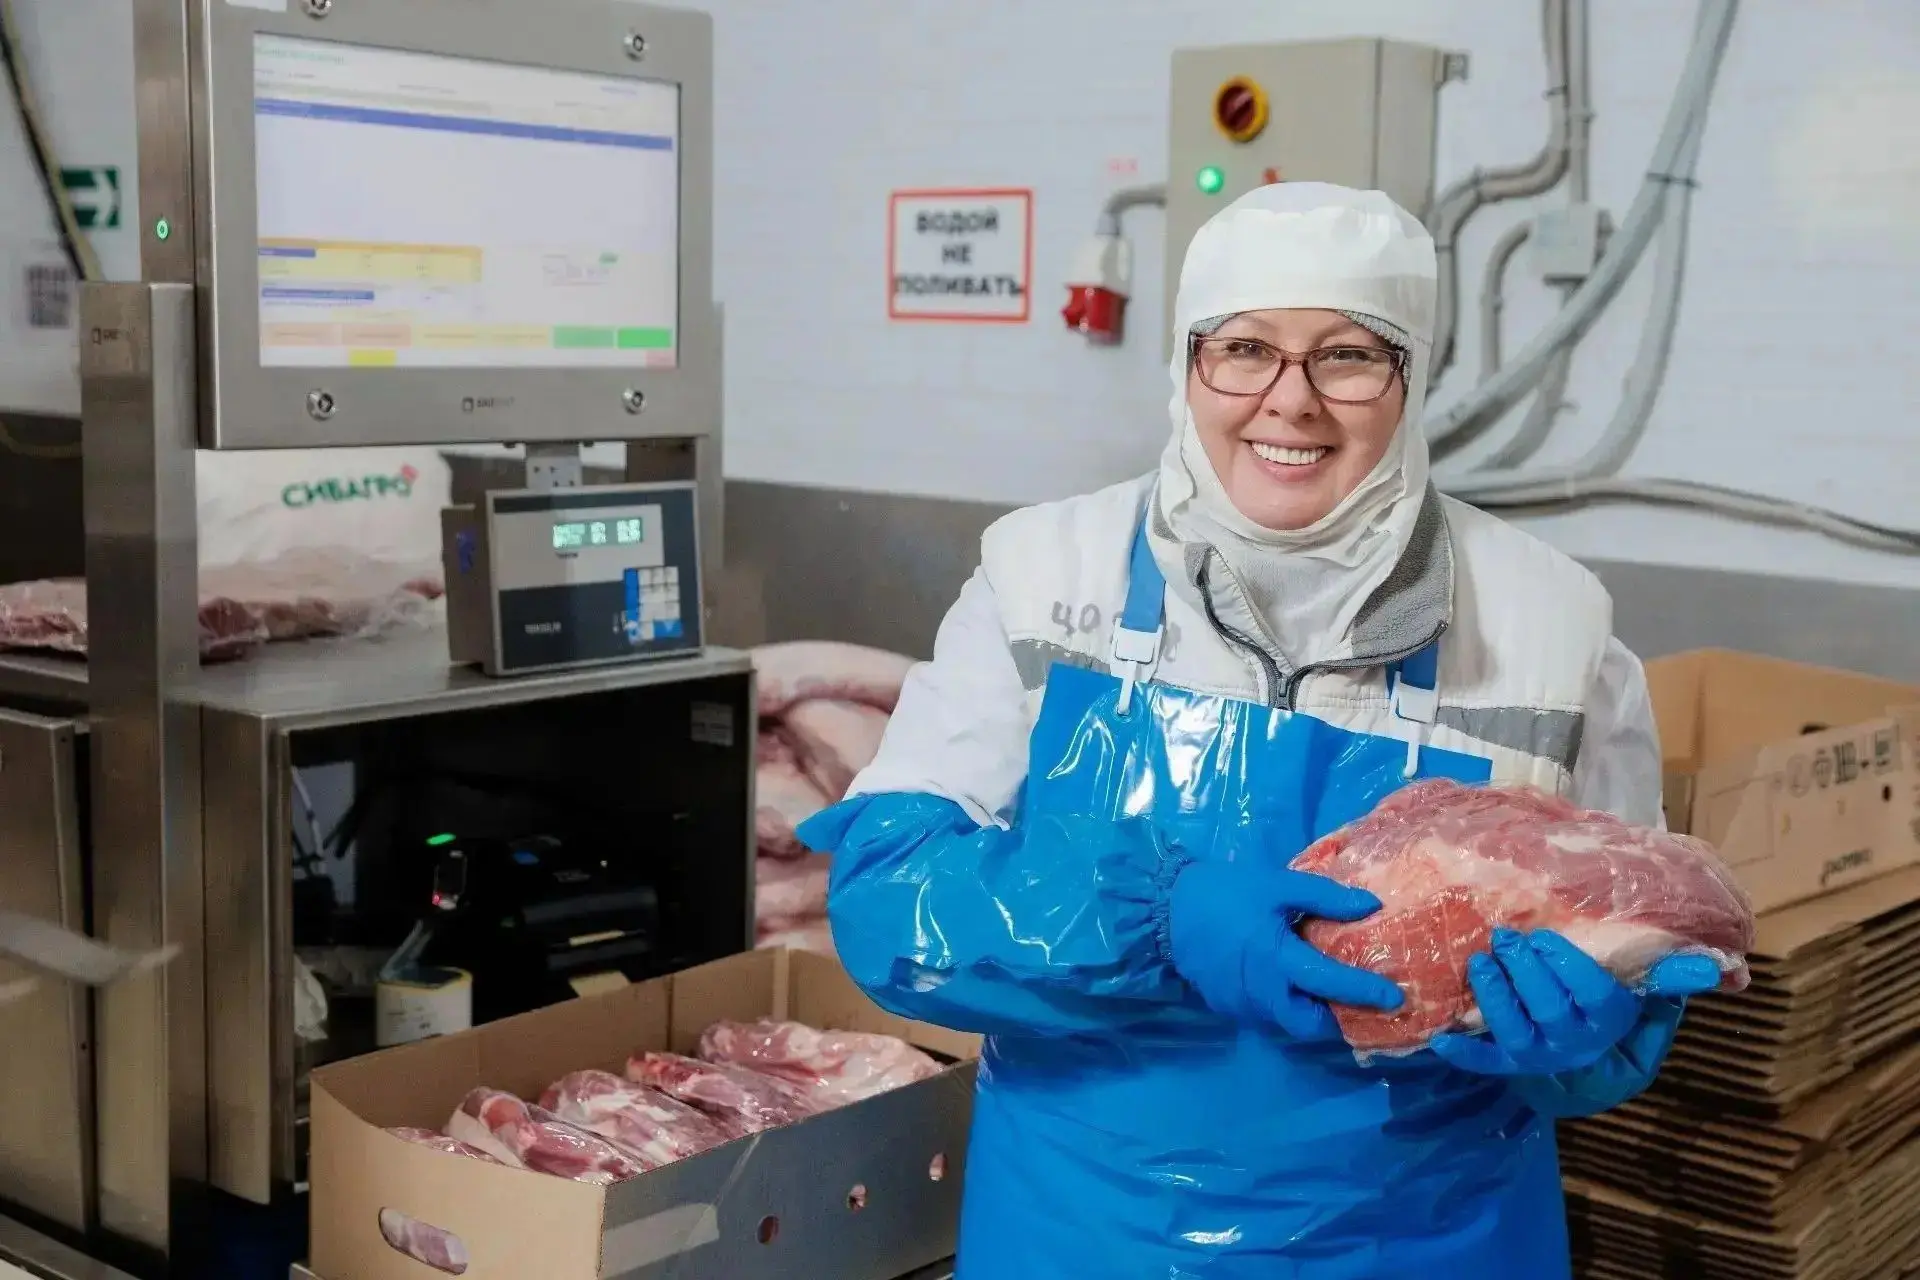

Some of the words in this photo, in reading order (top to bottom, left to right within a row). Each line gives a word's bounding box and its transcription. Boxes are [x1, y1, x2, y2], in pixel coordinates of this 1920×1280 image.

[916, 208, 998, 234] ВОДОЙ
[942, 244, 971, 264] НЕ
[894, 275, 1023, 296] ПОЛИВАТЬ
[282, 474, 412, 508] СИВАГРО
